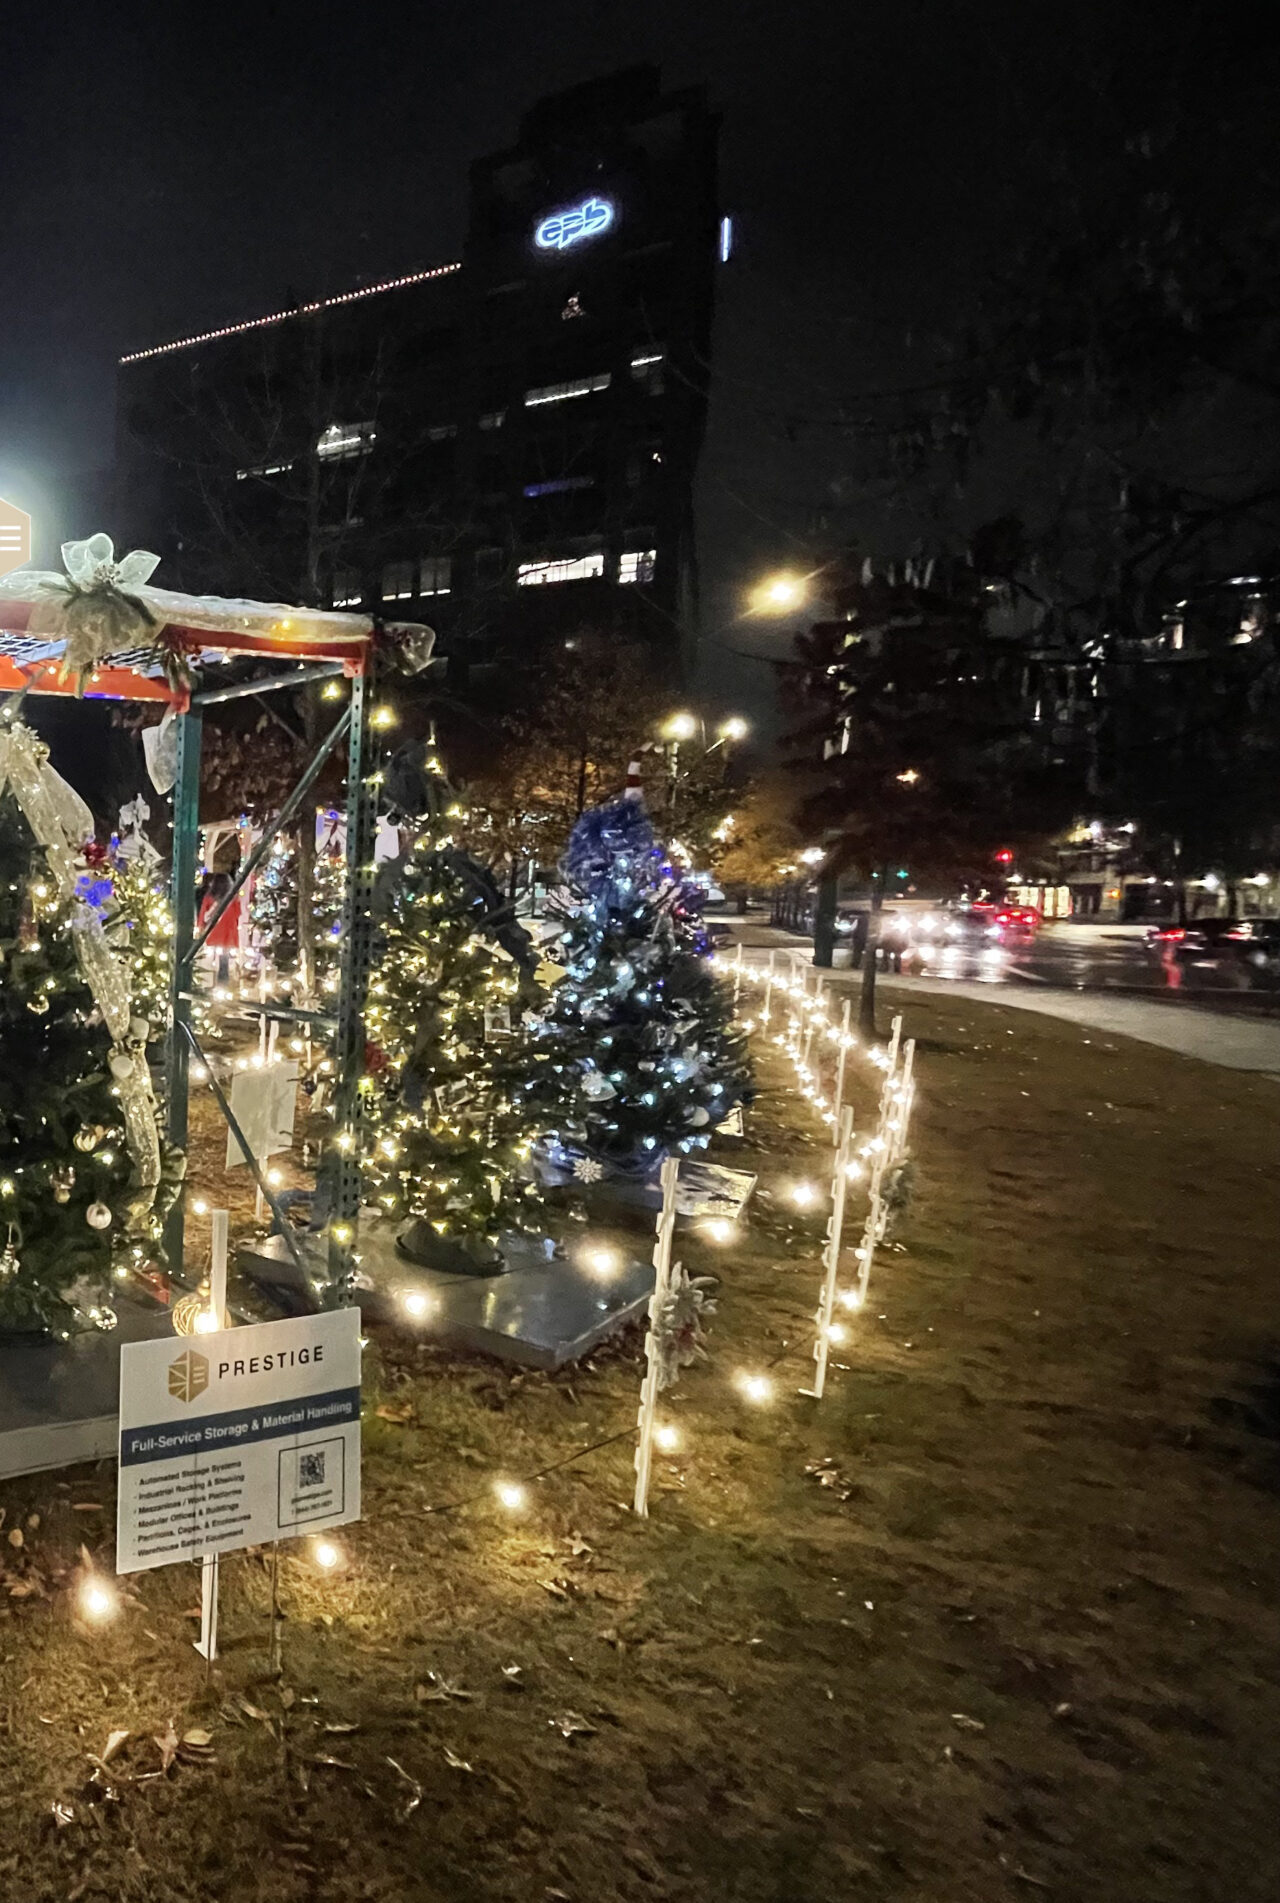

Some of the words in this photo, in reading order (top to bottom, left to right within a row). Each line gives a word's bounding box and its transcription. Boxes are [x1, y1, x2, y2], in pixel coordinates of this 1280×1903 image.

[536, 197, 613, 250] epb
[218, 1345, 324, 1380] PRESTIGE
[131, 1431, 202, 1453] Full-Service
[204, 1424, 249, 1438] Storage
[251, 1419, 260, 1431] &
[262, 1408, 305, 1428] Material
[307, 1401, 353, 1418] Handling
